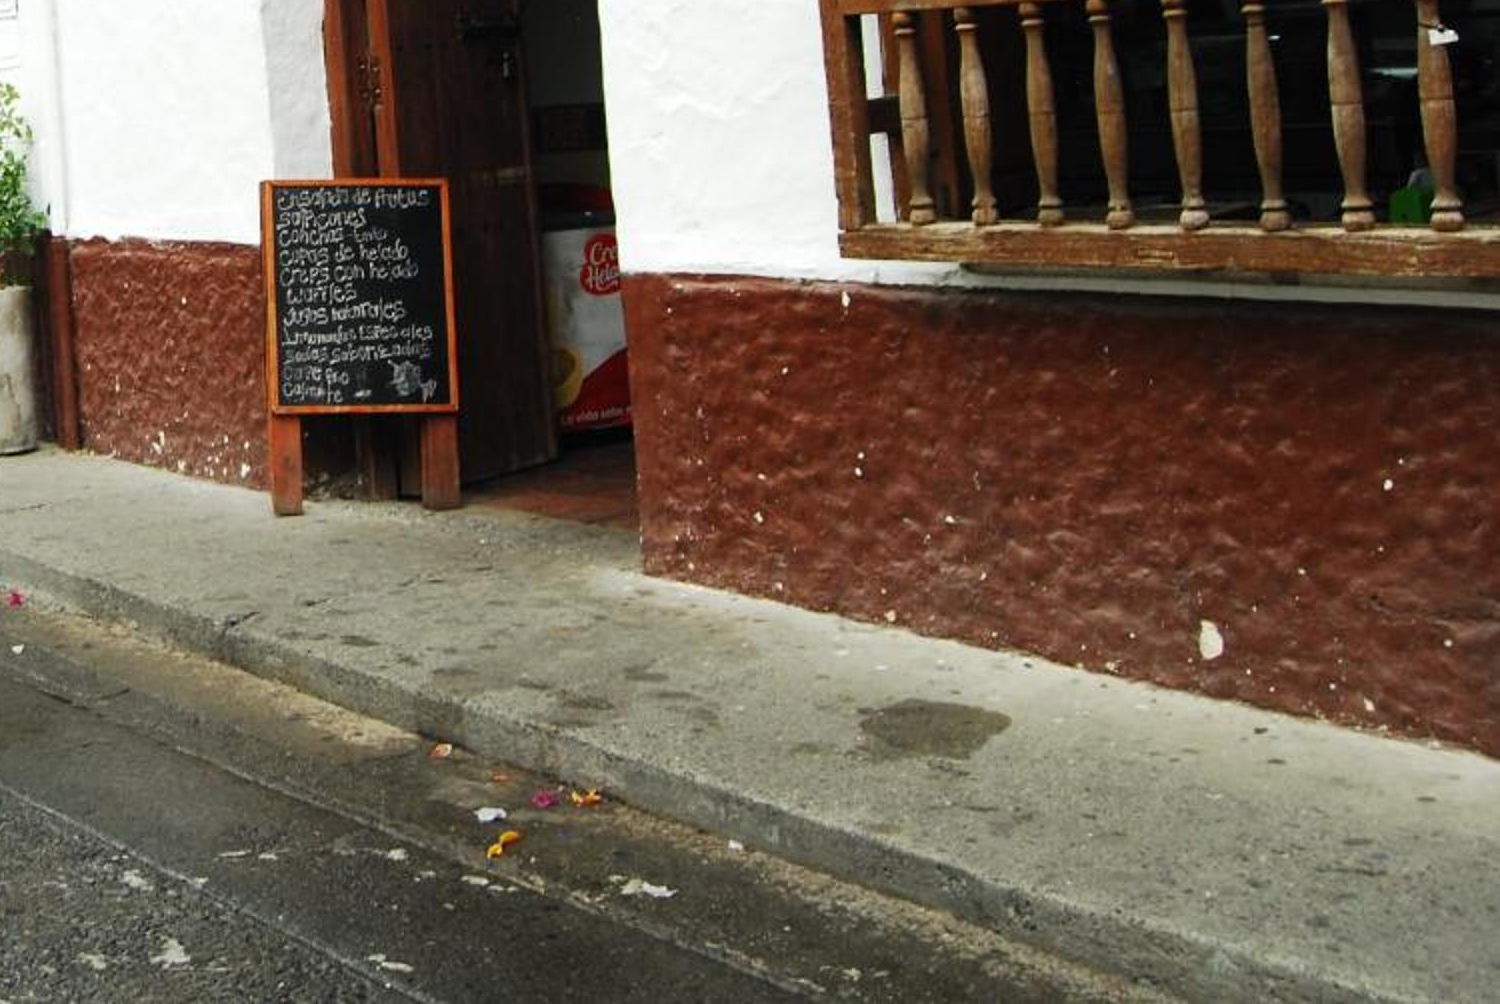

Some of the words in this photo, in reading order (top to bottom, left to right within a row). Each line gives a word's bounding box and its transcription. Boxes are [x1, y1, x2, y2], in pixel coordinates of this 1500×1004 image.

[353, 188, 371, 205] de
[335, 243, 355, 262] de
[360, 238, 409, 261] helado
